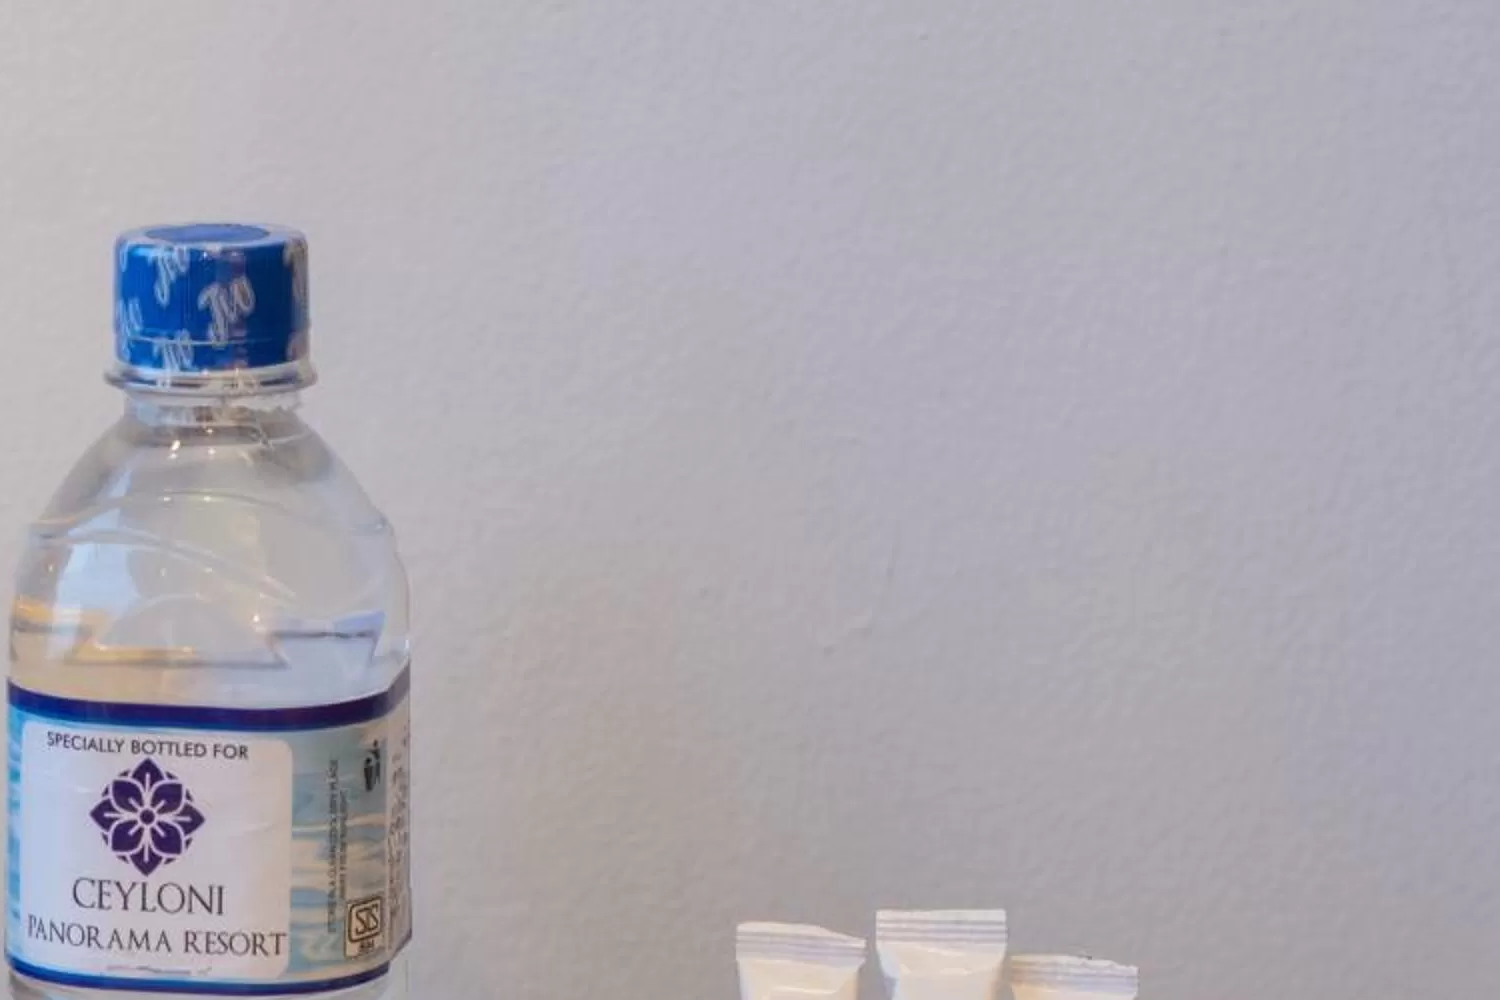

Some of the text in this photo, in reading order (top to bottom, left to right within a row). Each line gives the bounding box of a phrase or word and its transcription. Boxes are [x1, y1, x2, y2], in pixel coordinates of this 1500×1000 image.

[46, 731, 249, 760] SPECIALLY BOTTLED FOR
[72, 877, 225, 917] CEYLONI
[27, 914, 288, 957] PANORAMA RESORT
